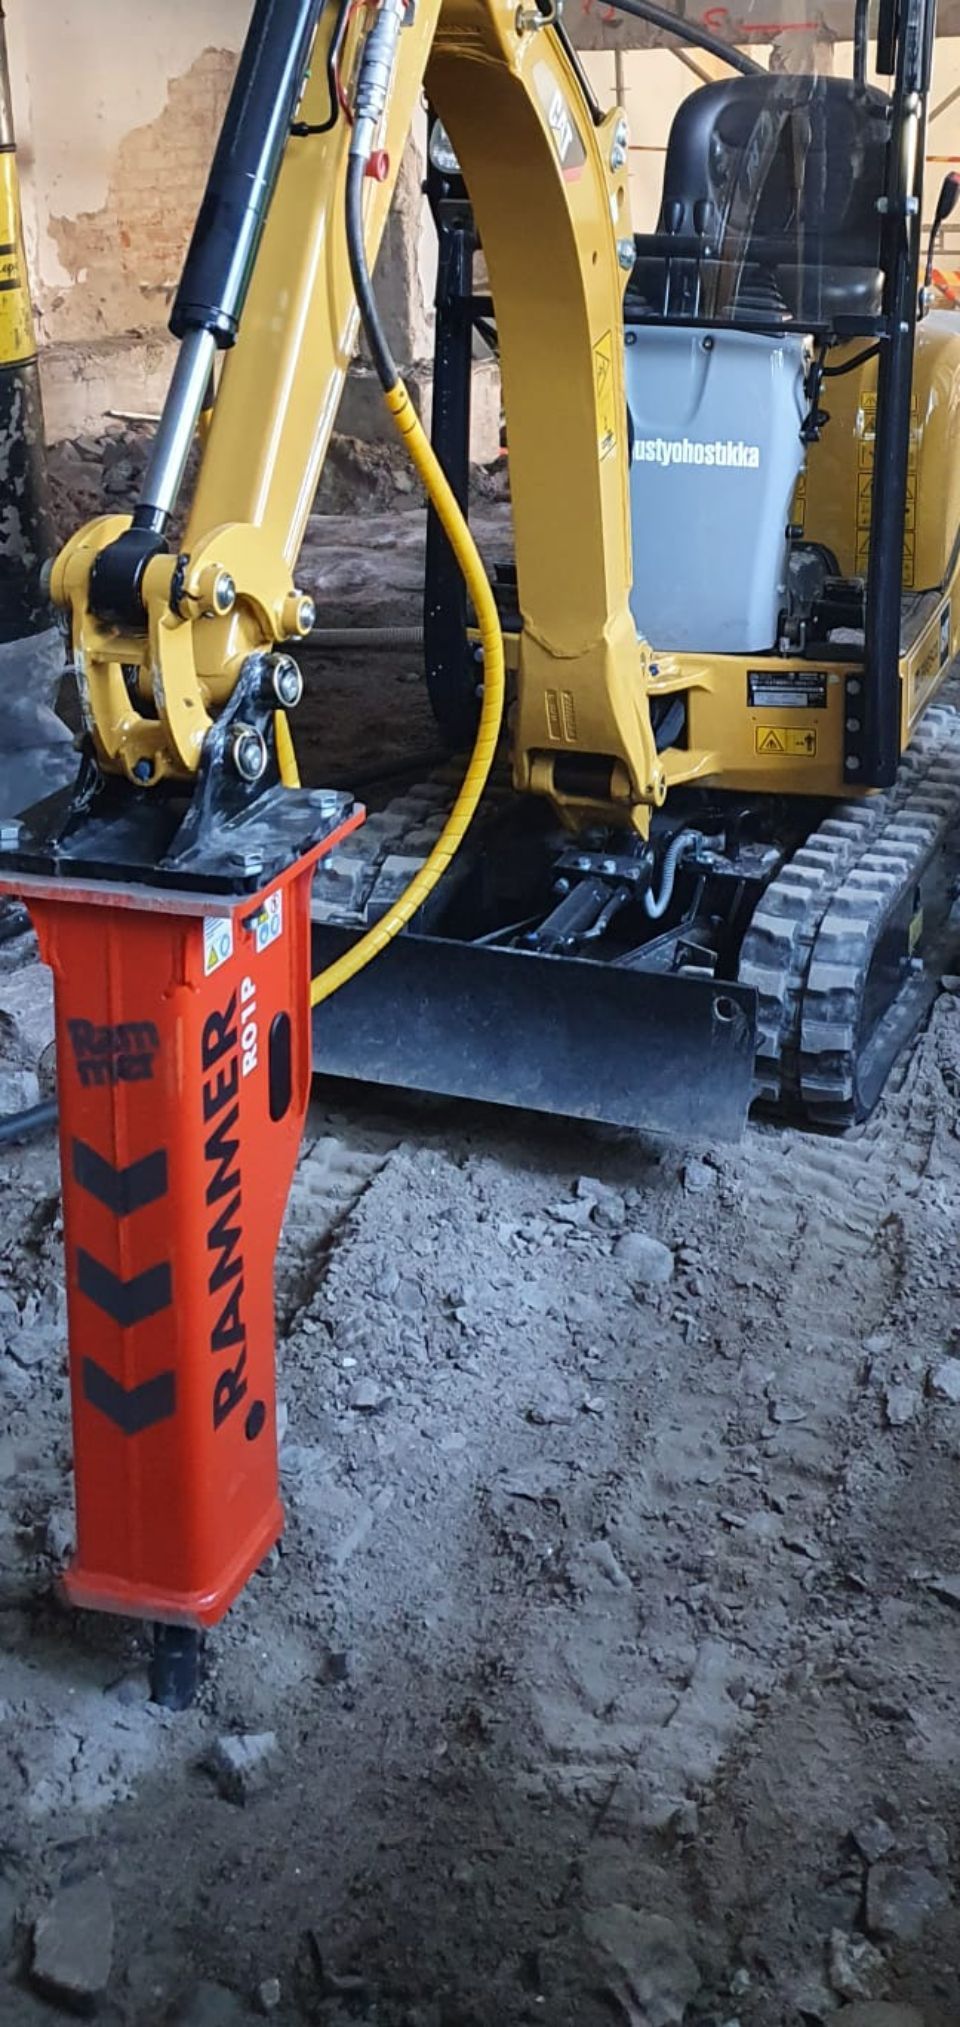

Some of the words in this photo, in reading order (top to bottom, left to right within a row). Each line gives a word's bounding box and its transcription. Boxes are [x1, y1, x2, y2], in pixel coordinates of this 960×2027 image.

[548, 88, 573, 162] CAT
[632, 438, 760, 468] ustyohostikka
[202, 988, 247, 1431] RAMMER
